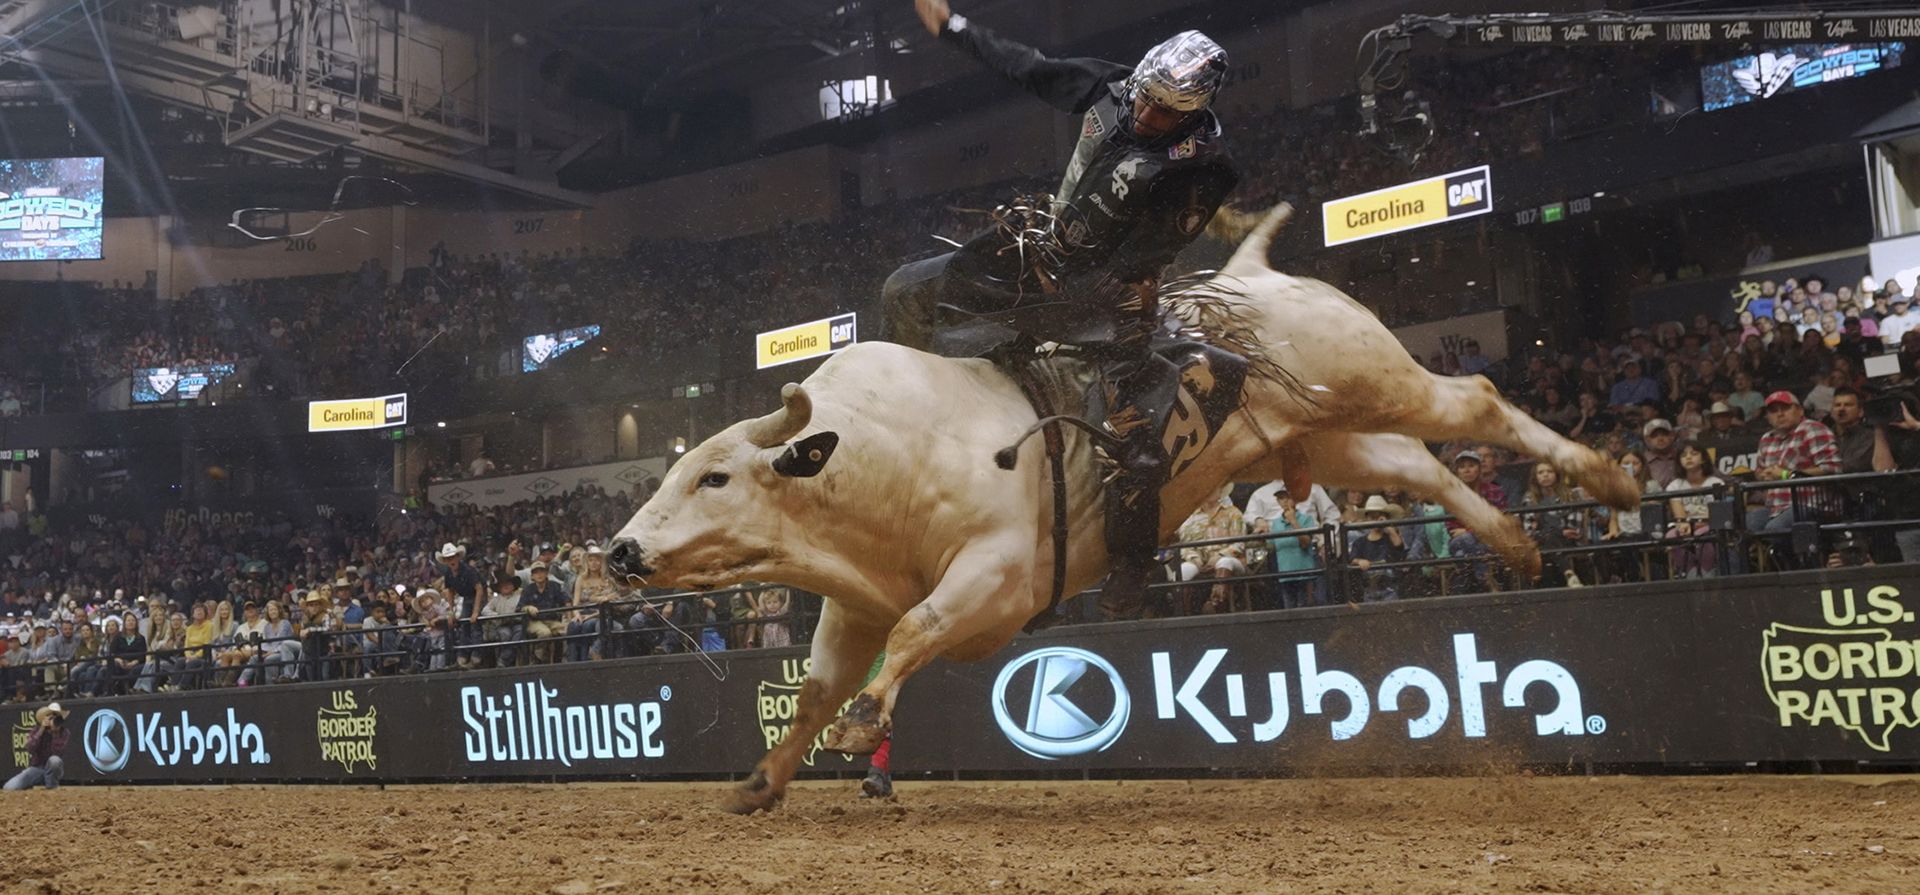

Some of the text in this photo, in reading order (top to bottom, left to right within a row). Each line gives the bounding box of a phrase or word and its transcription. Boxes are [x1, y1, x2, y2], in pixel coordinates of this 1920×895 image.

[1823, 65, 1855, 83] DAYS
[0, 197, 101, 220] OWBOY
[1346, 178, 1486, 230] Carolina CAT
[514, 218, 544, 234] 207
[1516, 209, 1537, 226] 107
[284, 237, 317, 252] 206
[769, 322, 853, 357] Carolina CAT
[323, 401, 404, 423] Carolina CAT
[1719, 453, 1758, 475] CAT
[1820, 585, 1915, 627] U.S.
[1769, 639, 1920, 682] BORD
[332, 690, 358, 710] U.S.
[1777, 687, 1920, 727] PATR
[320, 717, 376, 738] BORDER
[322, 740, 377, 761] PATROL
